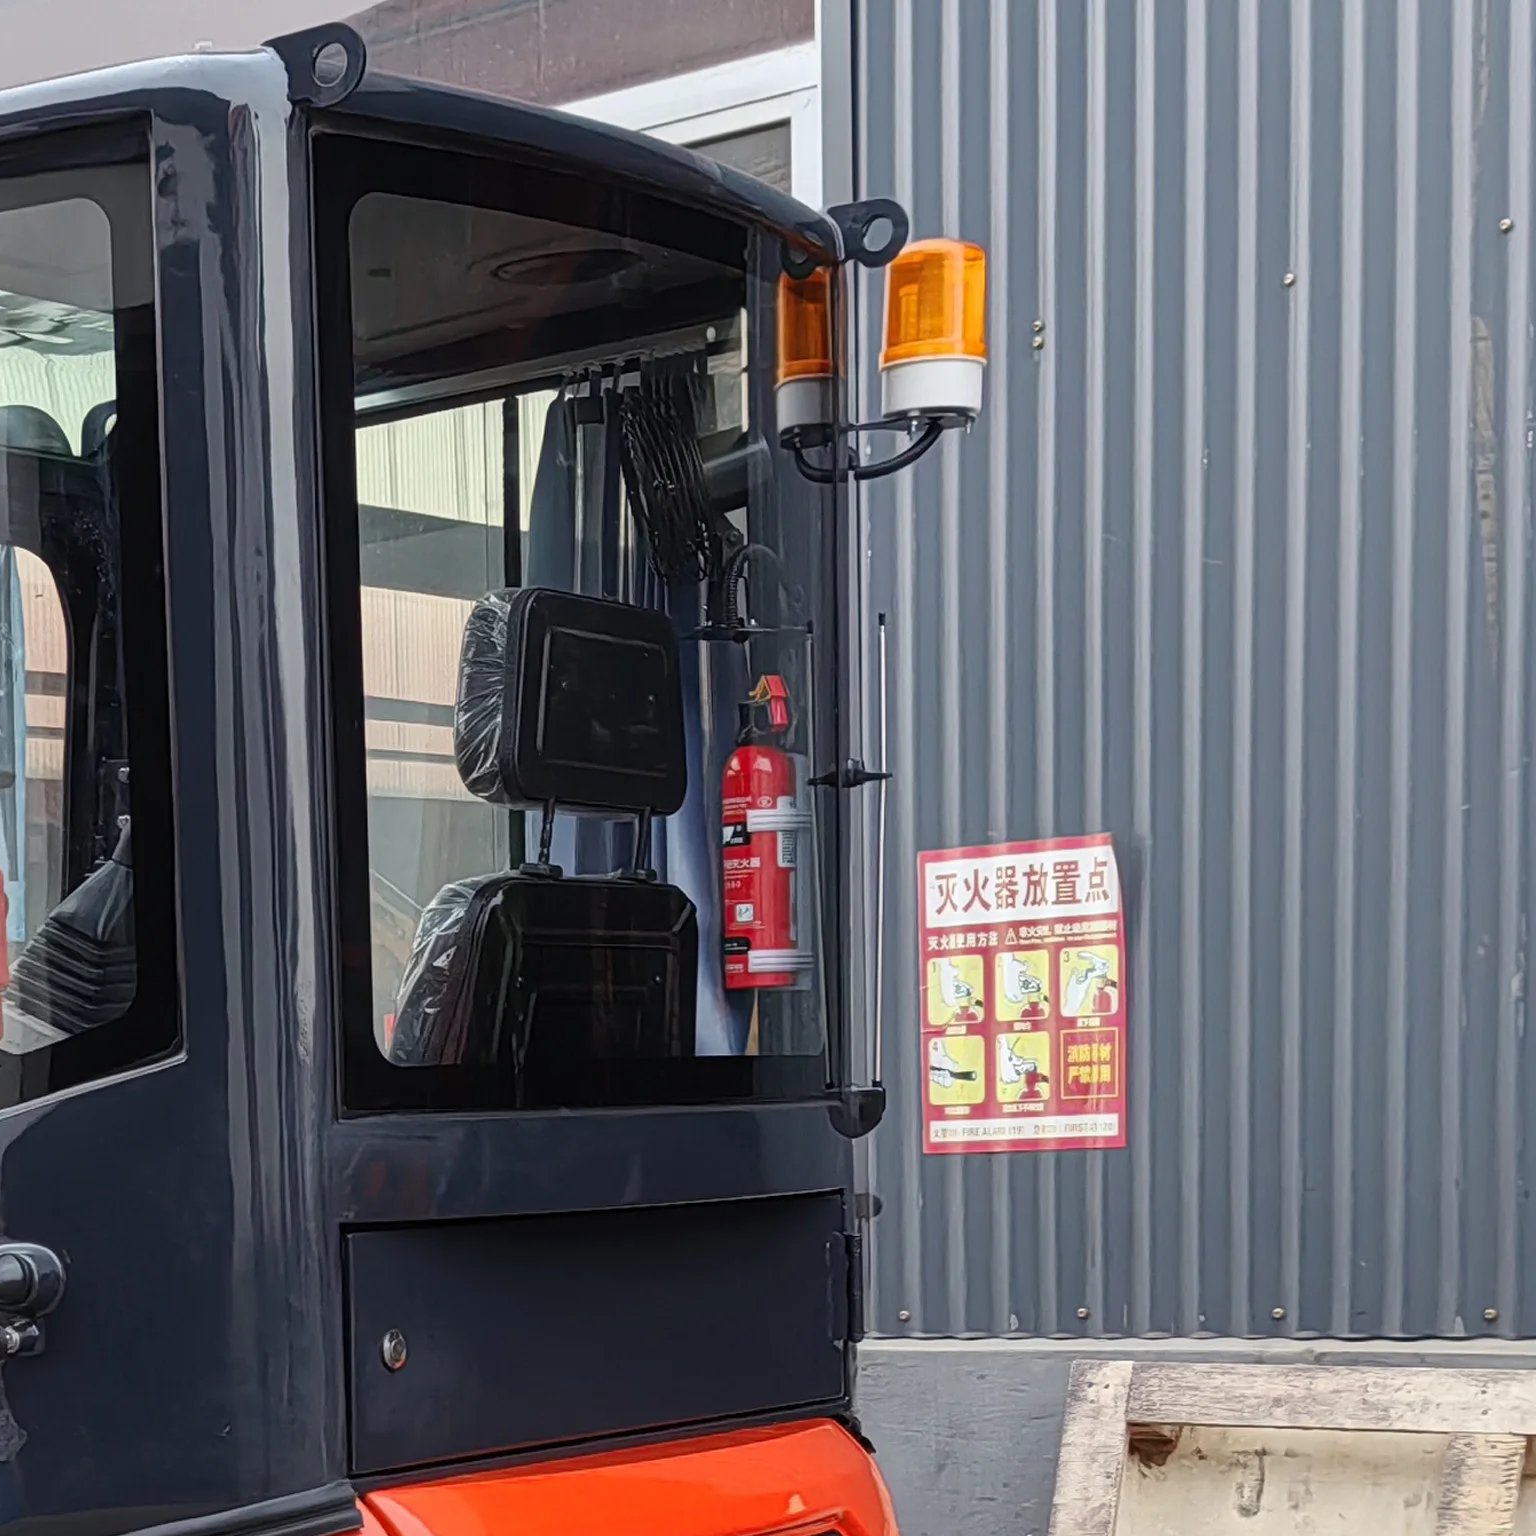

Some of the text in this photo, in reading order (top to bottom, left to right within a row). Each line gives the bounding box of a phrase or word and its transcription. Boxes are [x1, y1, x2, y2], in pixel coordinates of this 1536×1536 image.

[935, 857, 1110, 915] 灭火器放置点
[1064, 951, 1071, 963] 3
